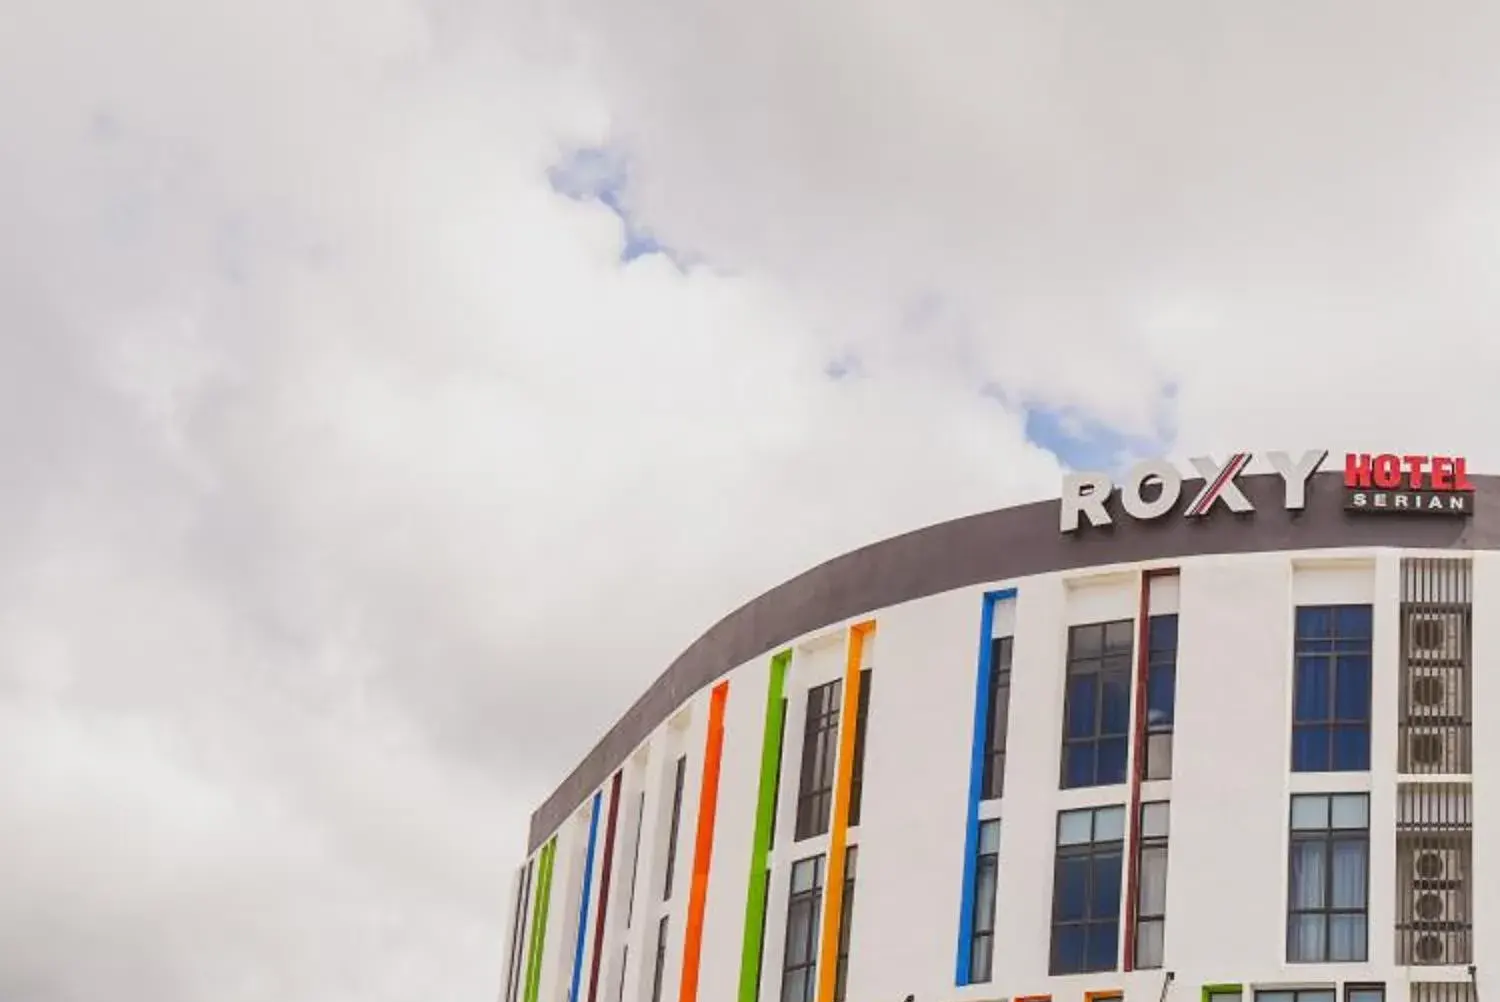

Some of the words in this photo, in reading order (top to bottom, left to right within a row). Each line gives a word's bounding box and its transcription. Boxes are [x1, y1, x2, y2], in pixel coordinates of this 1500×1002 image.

[1059, 449, 1329, 532] ROXY
[1344, 453, 1475, 491] HOTEL
[1353, 493, 1465, 510] SERIAN
